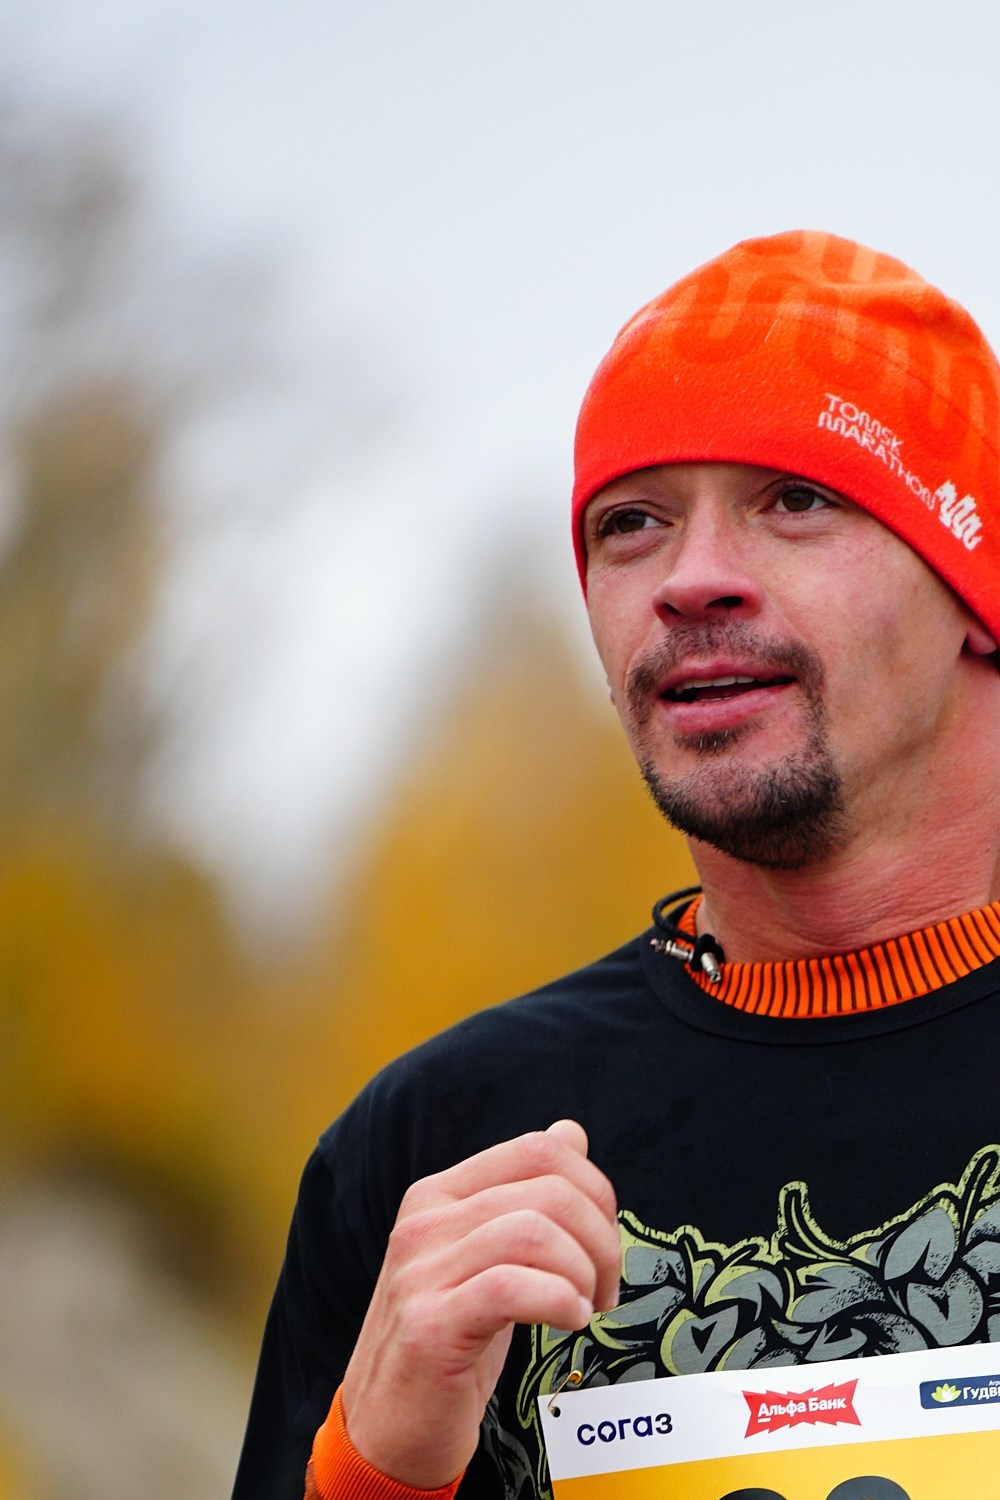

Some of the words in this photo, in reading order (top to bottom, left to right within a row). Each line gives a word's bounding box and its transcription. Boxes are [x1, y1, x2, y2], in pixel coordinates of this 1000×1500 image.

[824, 392, 903, 456] TOMSK
[817, 411, 937, 511] MARATHON
[757, 1399, 807, 1420] Альфа
[808, 1396, 847, 1412] Банк
